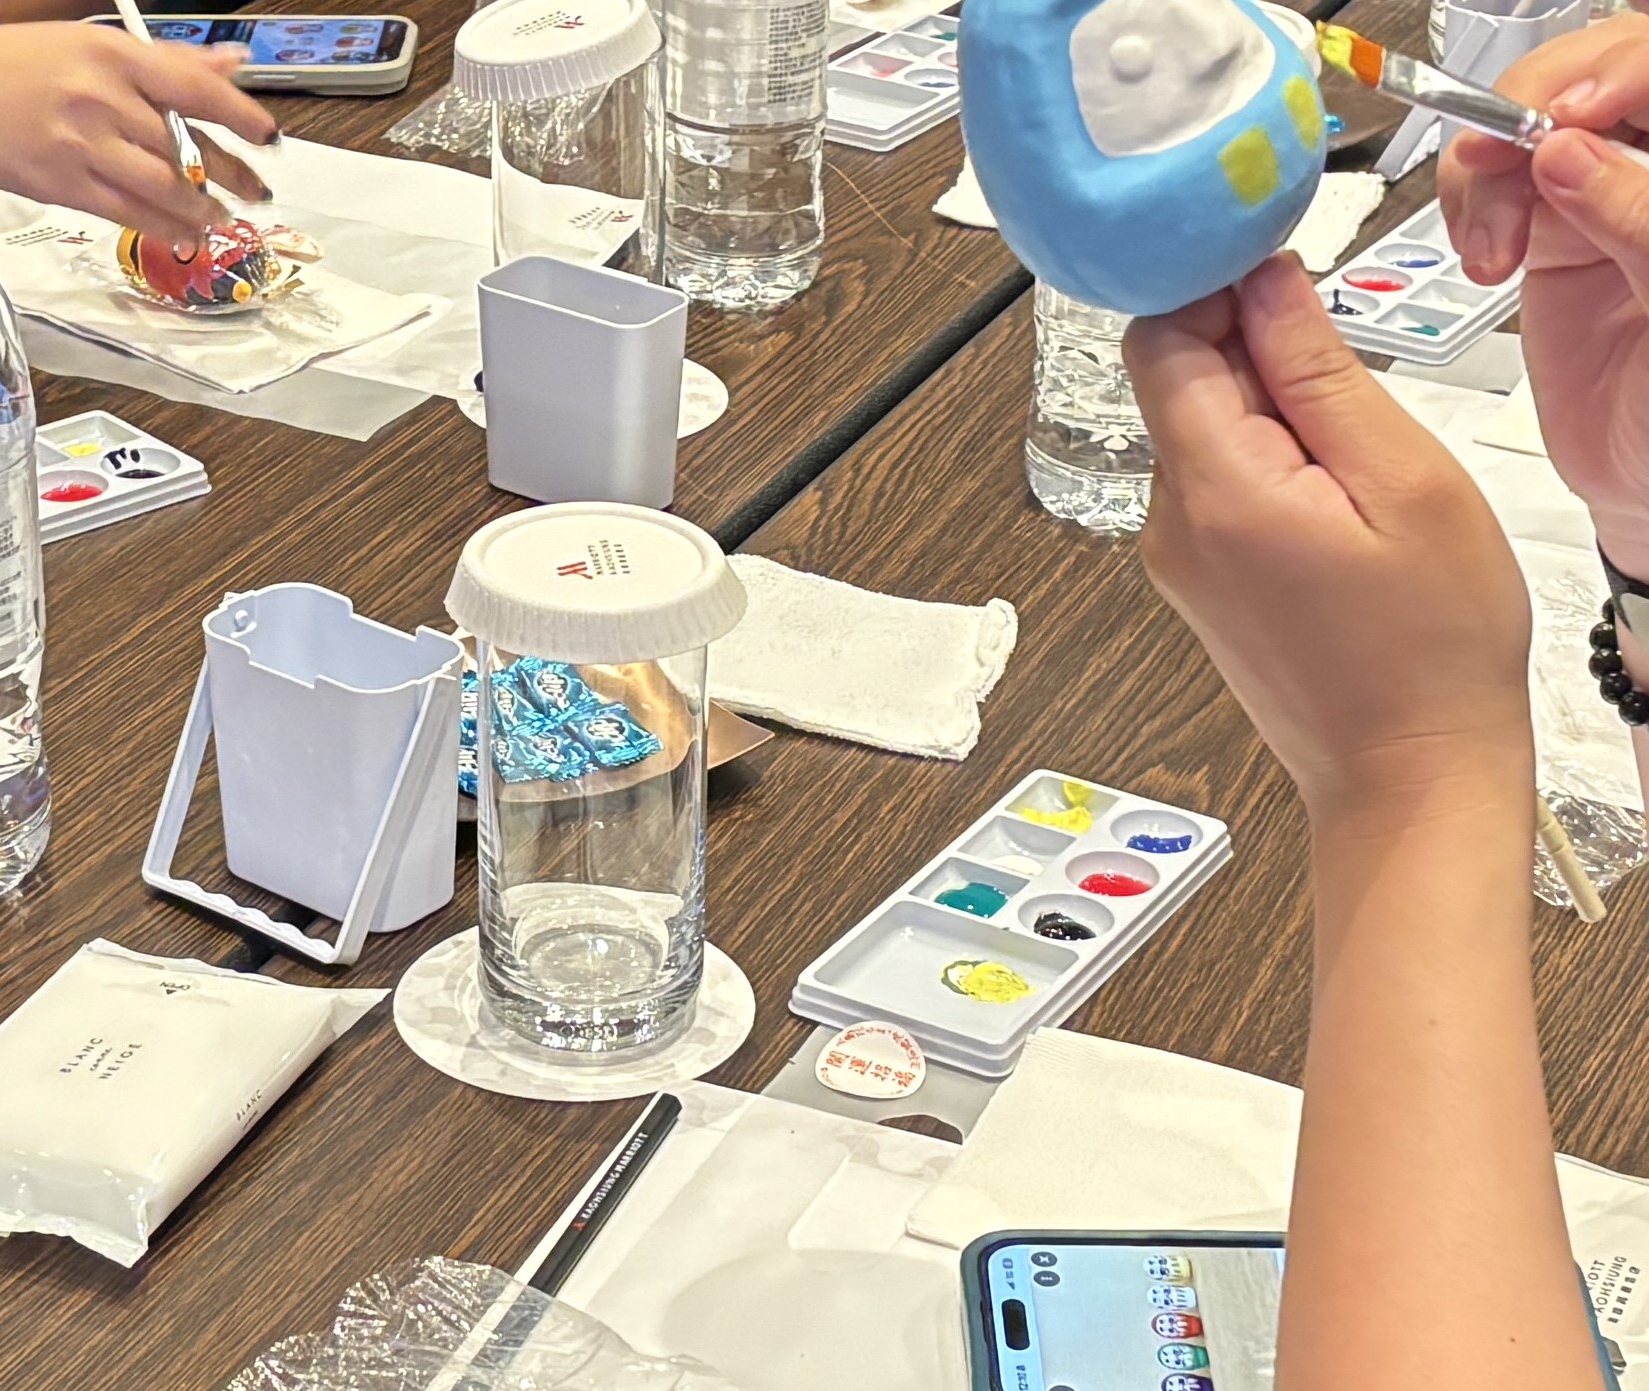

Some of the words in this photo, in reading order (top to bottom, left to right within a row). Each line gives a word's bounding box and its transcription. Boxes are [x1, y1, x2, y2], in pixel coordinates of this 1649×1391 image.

[59, 1037, 103, 1073] BLANC
[98, 1043, 143, 1079] NEIGE
[236, 1089, 263, 1121] BLANC
[614, 1132, 649, 1173] MARRIOTT
[1594, 1255, 1627, 1314] AOHSIUNG
